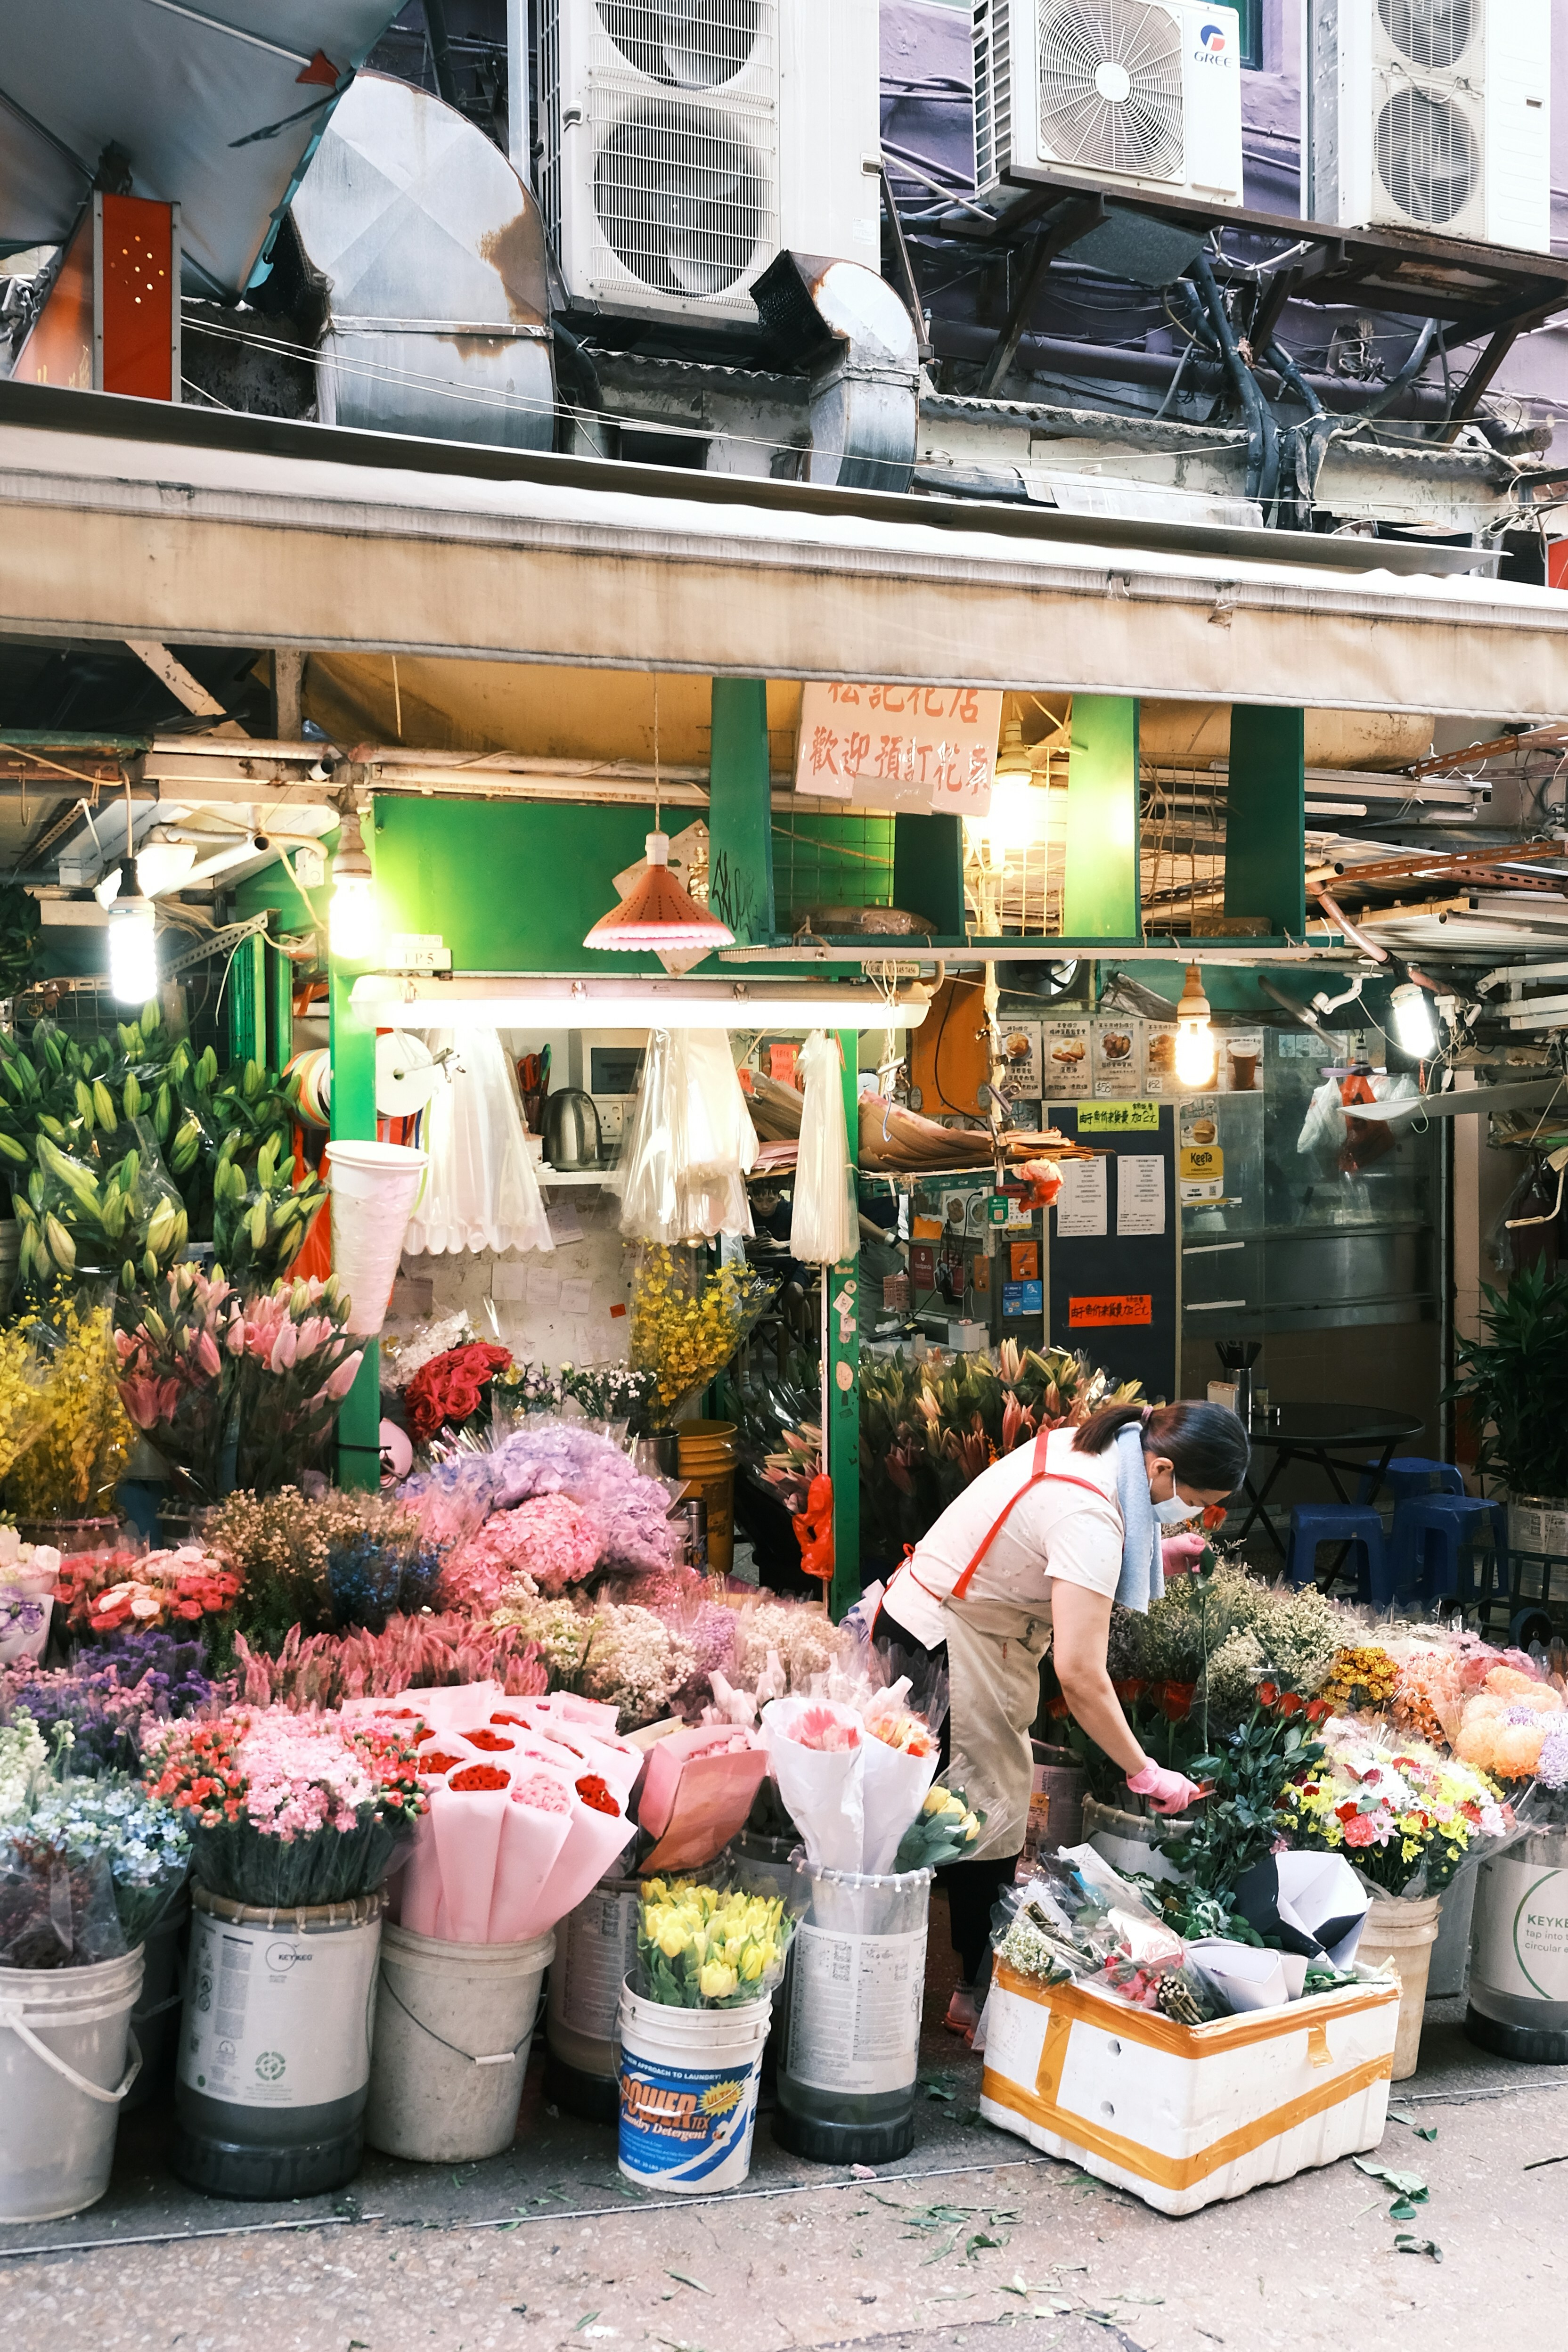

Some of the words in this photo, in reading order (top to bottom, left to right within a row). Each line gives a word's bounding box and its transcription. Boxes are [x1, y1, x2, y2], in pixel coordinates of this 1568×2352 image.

[1194, 51, 1233, 68] GREE
[828, 681, 980, 724] 松記花店
[1526, 1929, 1542, 1939] tap
[1545, 1931, 1563, 1940] into
[1525, 1941, 1561, 1952] circular
[637, 2062, 671, 2076] APPROACH
[621, 2074, 697, 2129] POWER
[692, 2115, 711, 2130] TEX
[652, 2122, 707, 2142] Detergent
